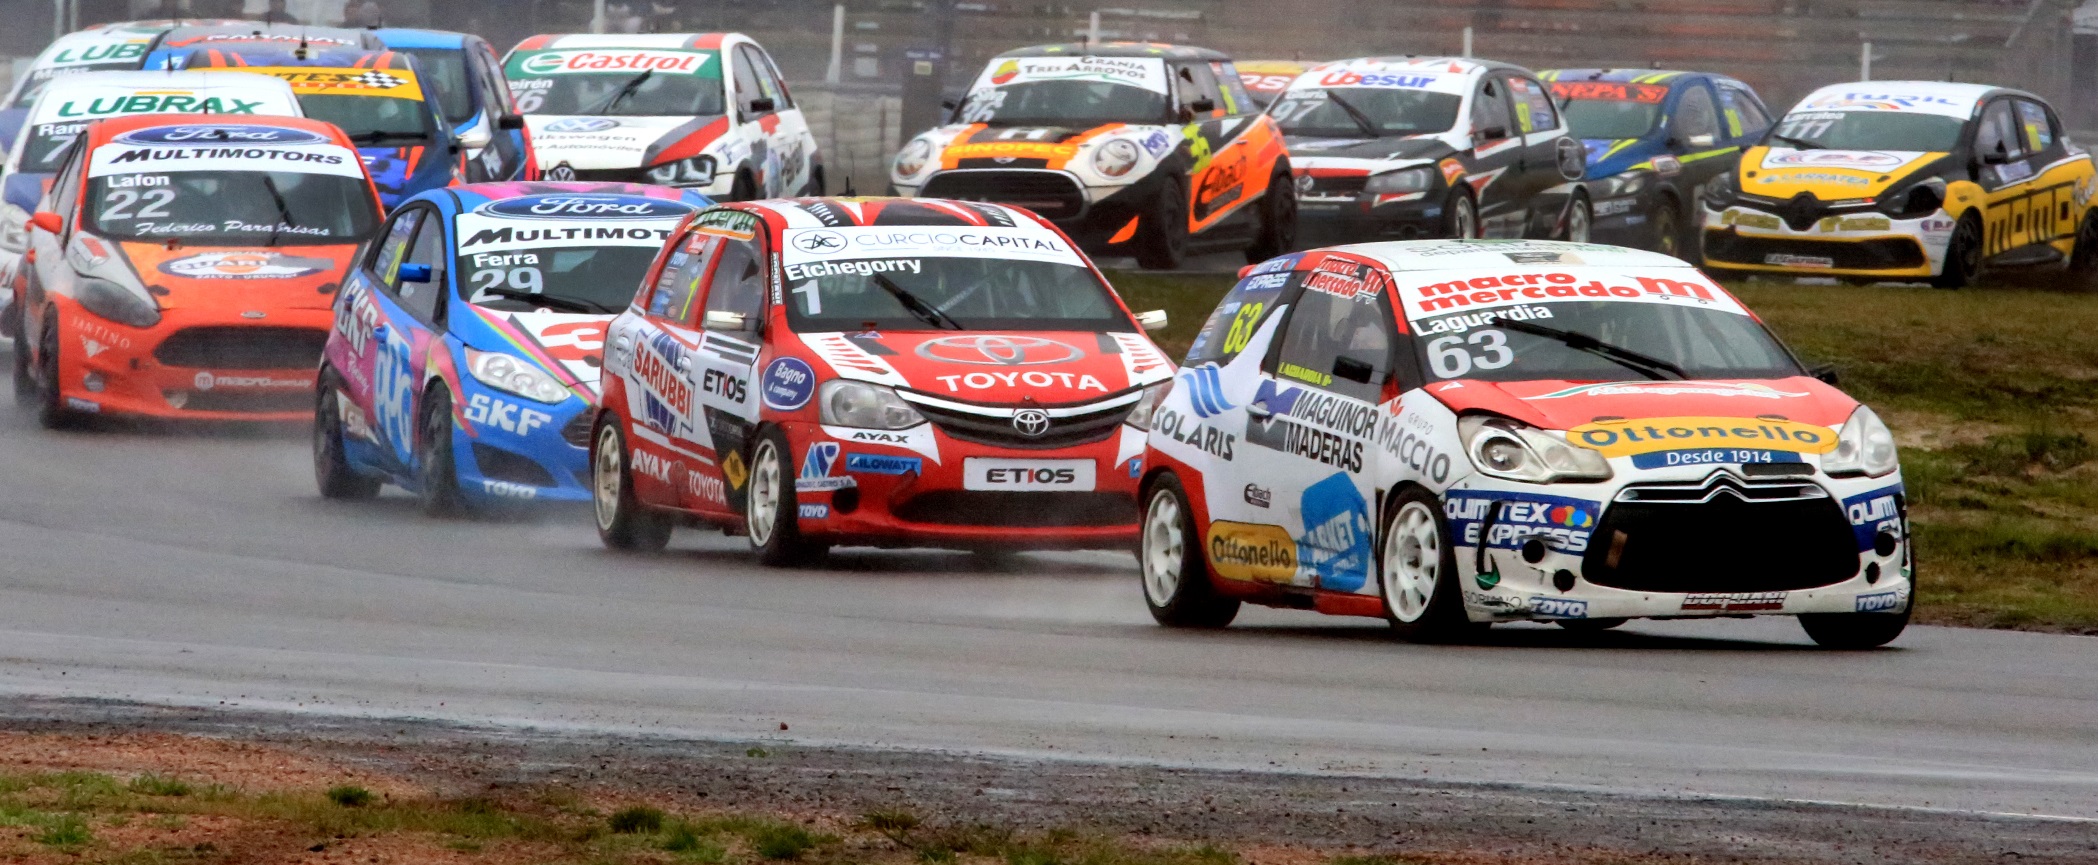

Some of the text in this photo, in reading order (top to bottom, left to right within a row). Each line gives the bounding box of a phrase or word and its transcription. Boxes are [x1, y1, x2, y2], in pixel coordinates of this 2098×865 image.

[567, 53, 697, 72] Castrol
[58, 95, 264, 117] LUBRAX
[1272, 100, 1324, 122] 97
[165, 125, 279, 142] Ford
[109, 149, 343, 164] MULTIMOTORS
[946, 144, 1073, 158] SINOPEC
[107, 175, 171, 189] Lafon
[100, 189, 176, 221] 22
[531, 196, 654, 215] Ford
[135, 219, 331, 237] Federico Parabrisas
[473, 252, 539, 269] Ferra
[784, 259, 922, 281] Etchegorry
[470, 267, 543, 304] 29
[1418, 273, 1577, 298] macro
[1418, 281, 1640, 312] mercado
[792, 279, 822, 315] 1
[1223, 302, 1263, 354] 63
[1410, 305, 1554, 337] Laguardia
[1427, 329, 1514, 379] 63
[635, 341, 692, 421] SARUBBI
[775, 362, 806, 385] Bagno
[936, 371, 1109, 392] TOYOTA
[704, 367, 747, 404] ETIOS
[464, 393, 551, 437] SKF
[1290, 389, 1378, 440] MAGUINOR
[853, 431, 909, 443] AYAX
[1151, 405, 1237, 462] SOLARIS
[1582, 425, 1821, 446] Ottonello
[1286, 421, 1364, 474] MADERAS
[1378, 416, 1450, 484] MACCIO
[1667, 450, 1773, 465] Desde 1914
[631, 448, 727, 506] AYAX TOYOTA
[987, 468, 1075, 484] ETIOS
[799, 504, 827, 518] TOYO
[1532, 598, 1587, 617] TOYO
[1859, 595, 1896, 611] TOYO
